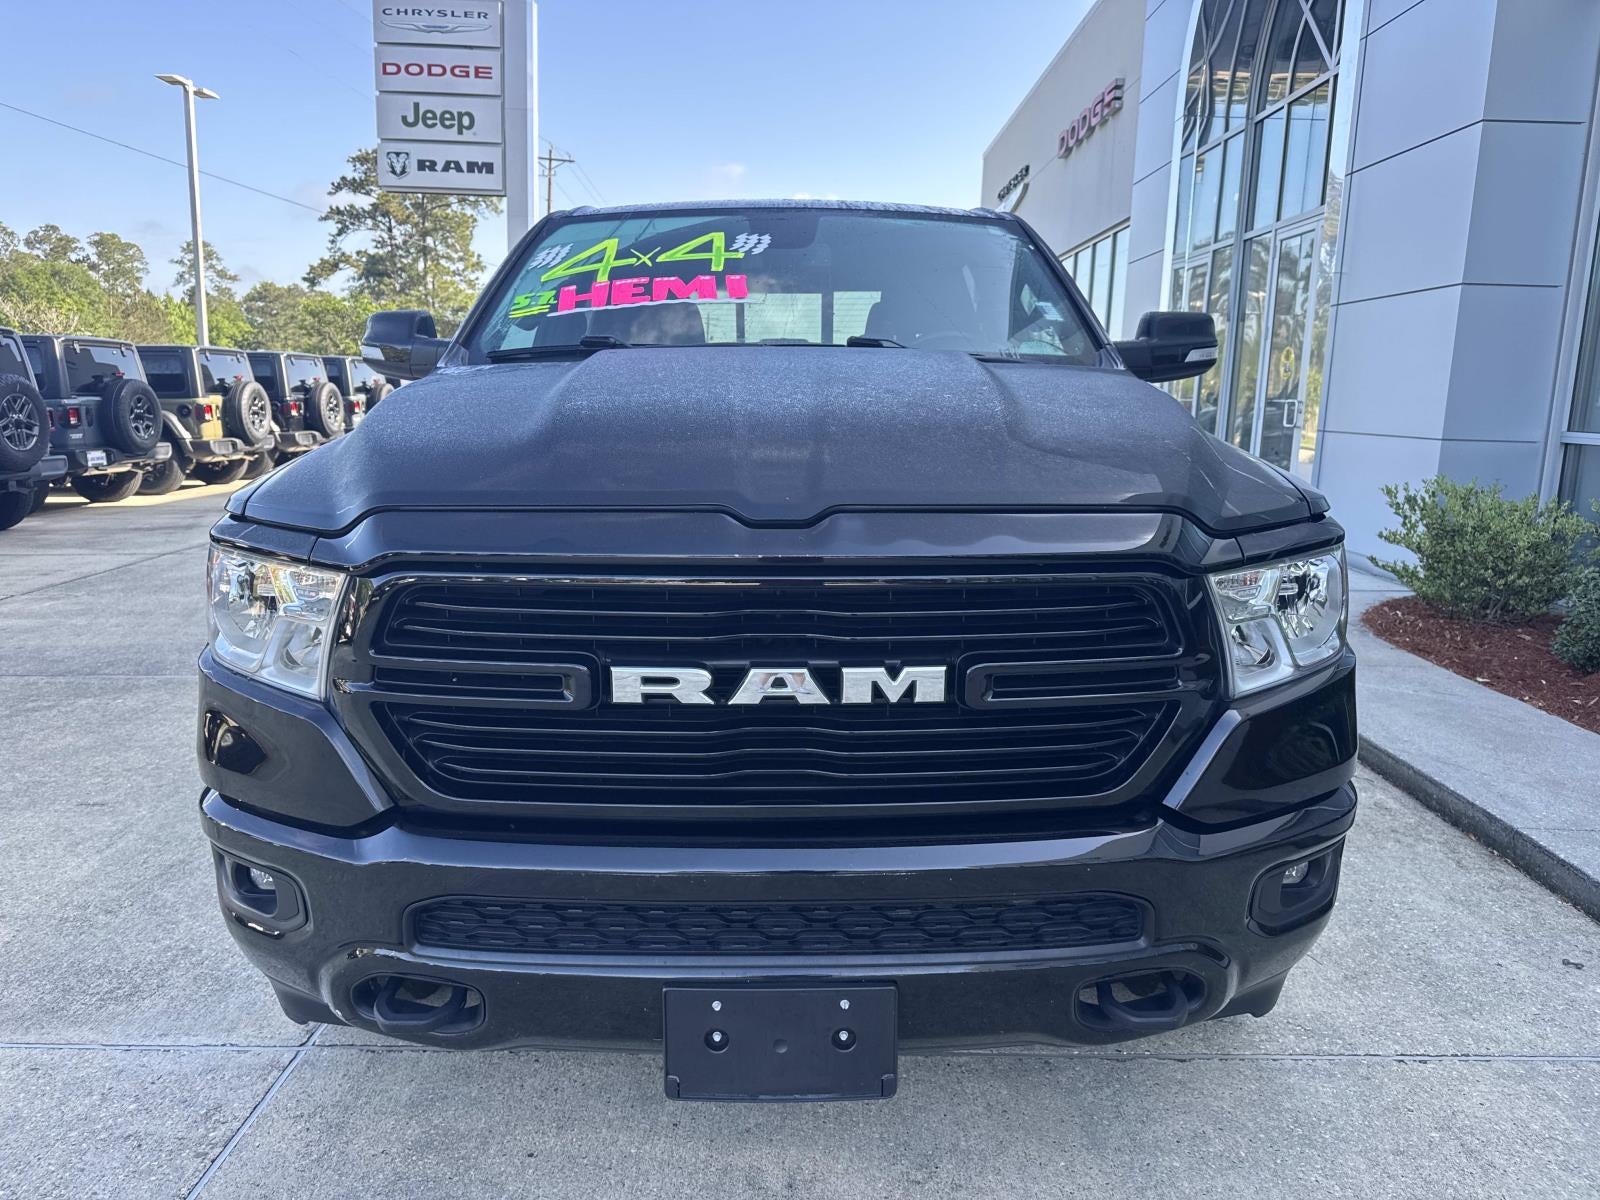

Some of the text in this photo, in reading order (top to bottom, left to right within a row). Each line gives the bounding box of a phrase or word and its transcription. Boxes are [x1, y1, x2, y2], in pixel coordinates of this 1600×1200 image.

[382, 7, 489, 20] CHRYSLER
[381, 62, 493, 79] DODGE
[401, 101, 476, 135] Jeep
[1057, 77, 1125, 159] DODGE
[416, 158, 494, 175] RAM
[558, 274, 748, 313] HEMI
[610, 666, 947, 705] RAM
